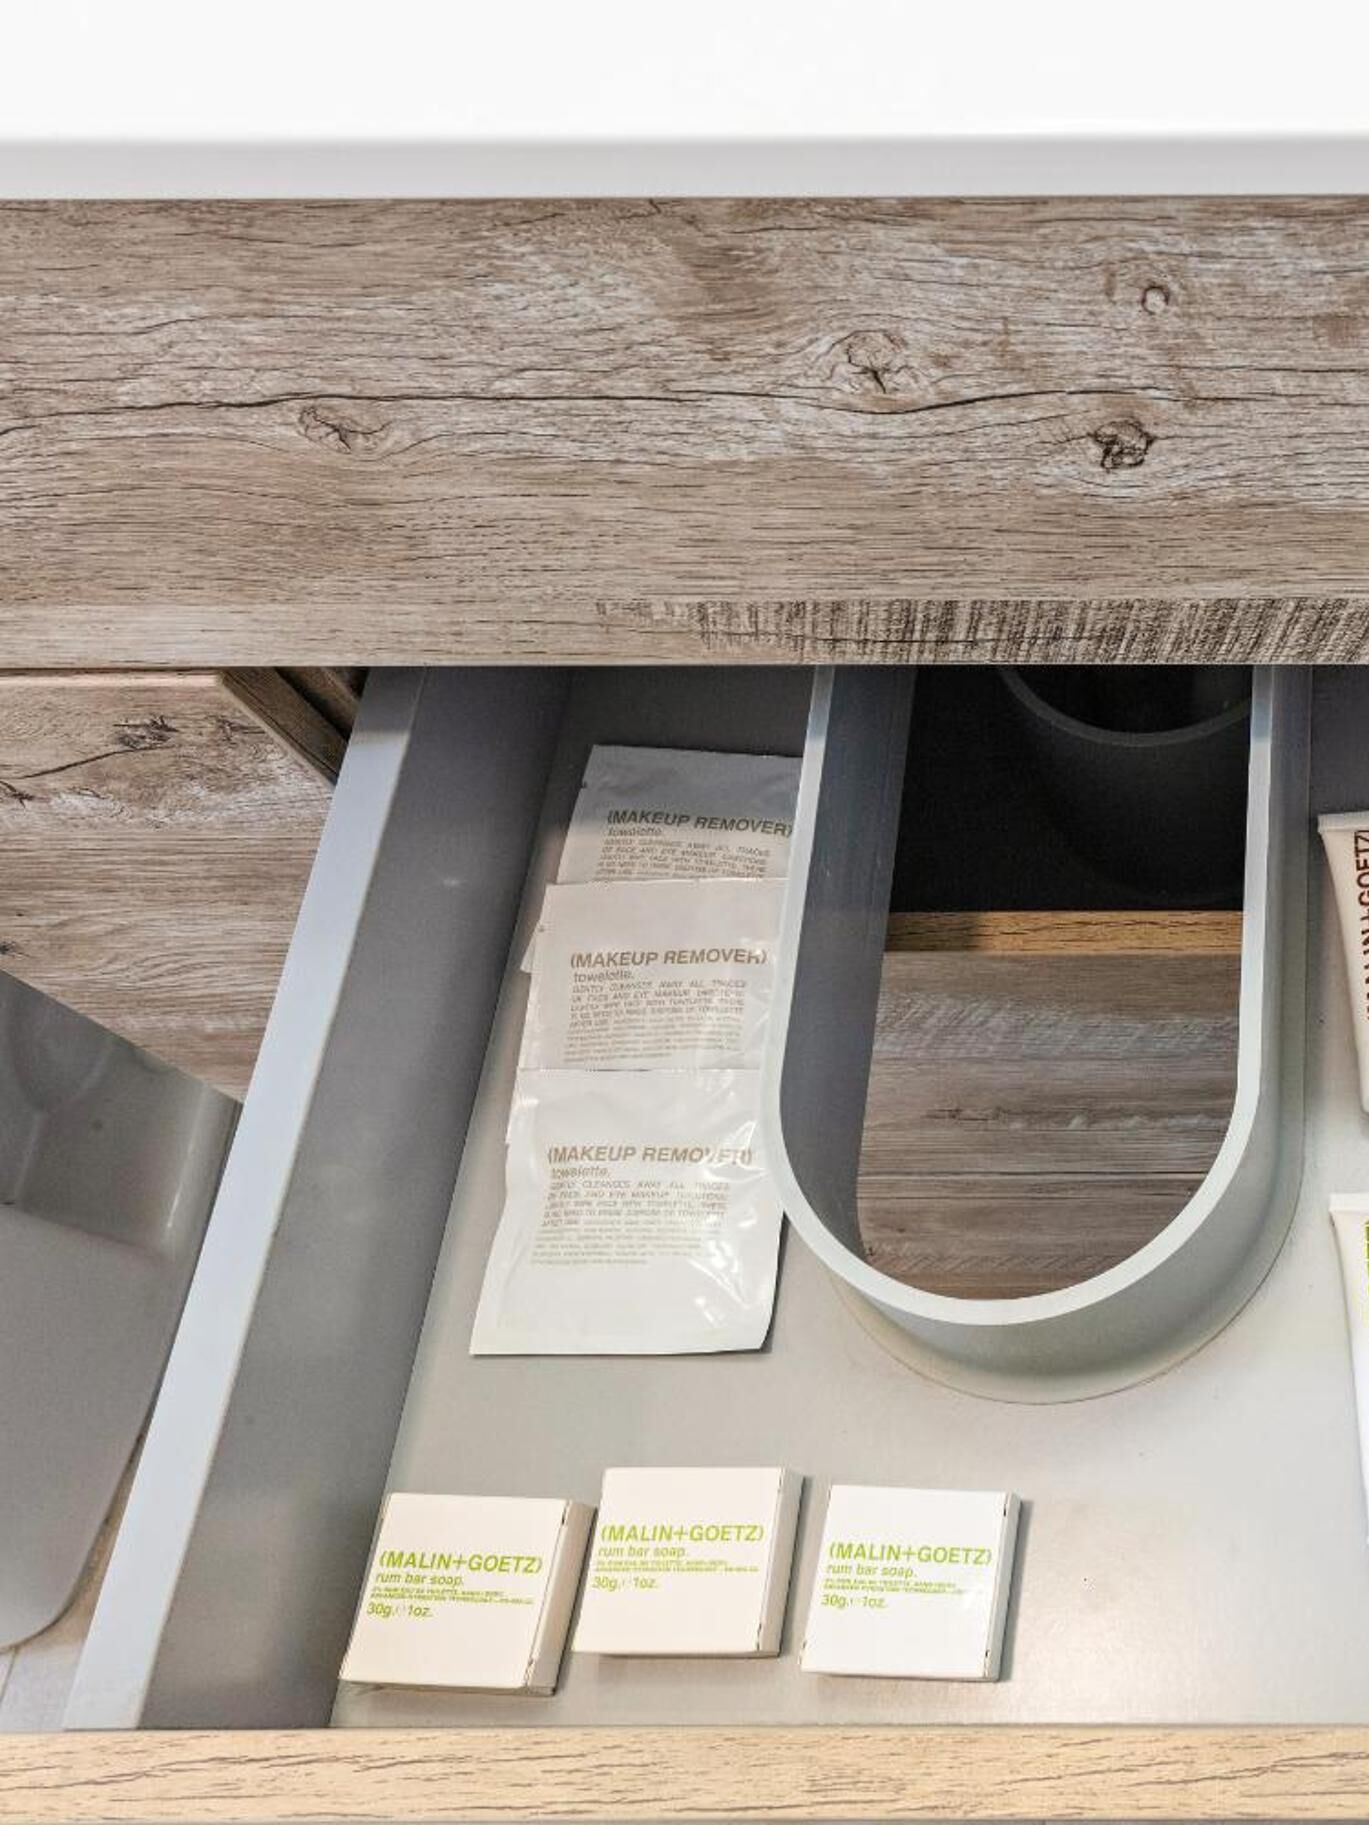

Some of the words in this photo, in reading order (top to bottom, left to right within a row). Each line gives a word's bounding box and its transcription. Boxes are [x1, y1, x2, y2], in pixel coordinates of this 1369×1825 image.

[571, 952, 659, 968] (MAKEUP
[548, 1146, 636, 1164] (MAKEUP
[601, 1525, 764, 1541] (MALIN+GOETZ)
[598, 1548, 623, 1557] rum
[628, 1546, 649, 1557] bar
[830, 1542, 992, 1566] (MALIN+GOETZ)
[380, 1551, 542, 1573] (MALIN+GOETZ)
[827, 1565, 852, 1574] rum
[857, 1565, 877, 1575] bar
[375, 1573, 400, 1583] rum
[405, 1574, 426, 1584] bar
